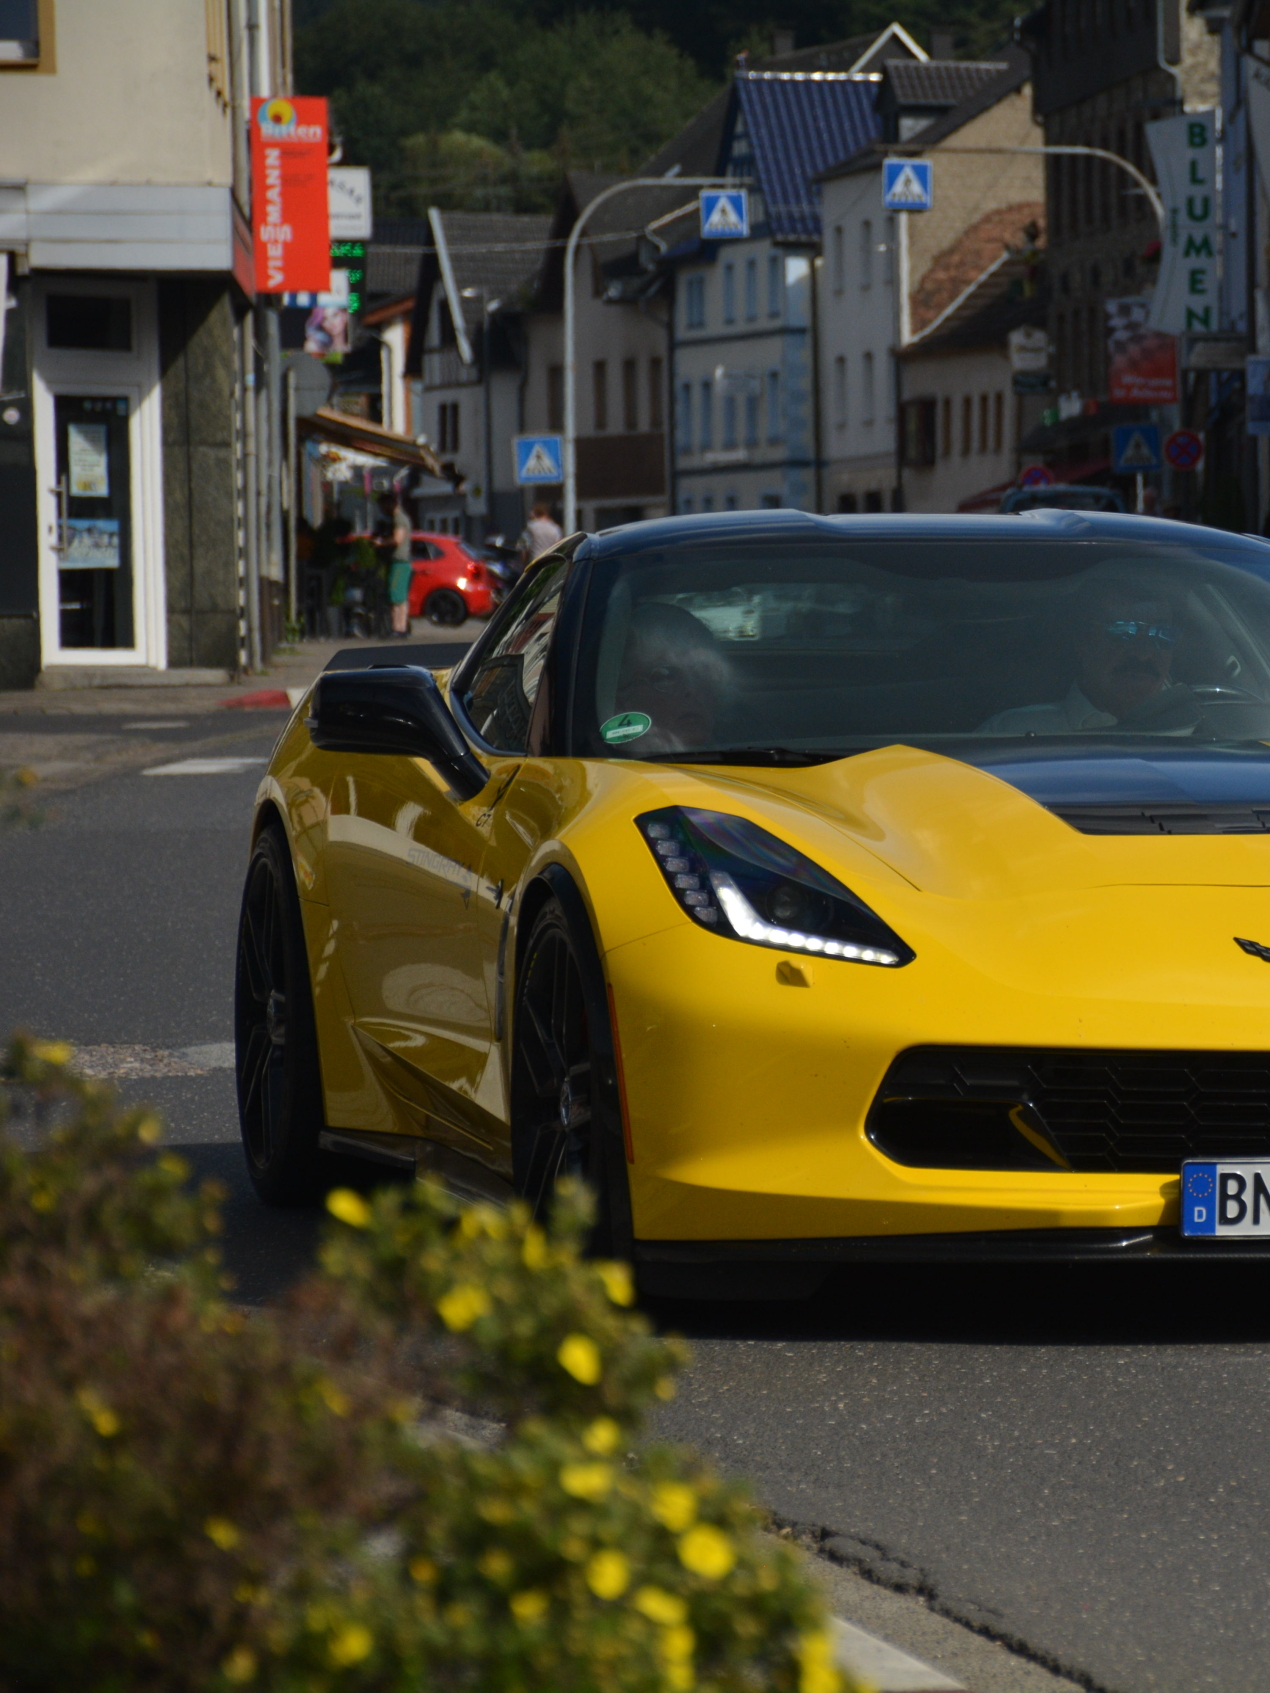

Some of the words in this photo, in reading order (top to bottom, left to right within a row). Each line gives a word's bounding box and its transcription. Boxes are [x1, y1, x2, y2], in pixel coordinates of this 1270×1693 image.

[260, 149, 292, 287] VIESSMANN
[1183, 122, 1213, 330] BLUMEN
[617, 714, 632, 726] 4
[475, 813, 492, 827] C7
[407, 847, 465, 878] STINGRAY
[1194, 1207, 1206, 1222] D
